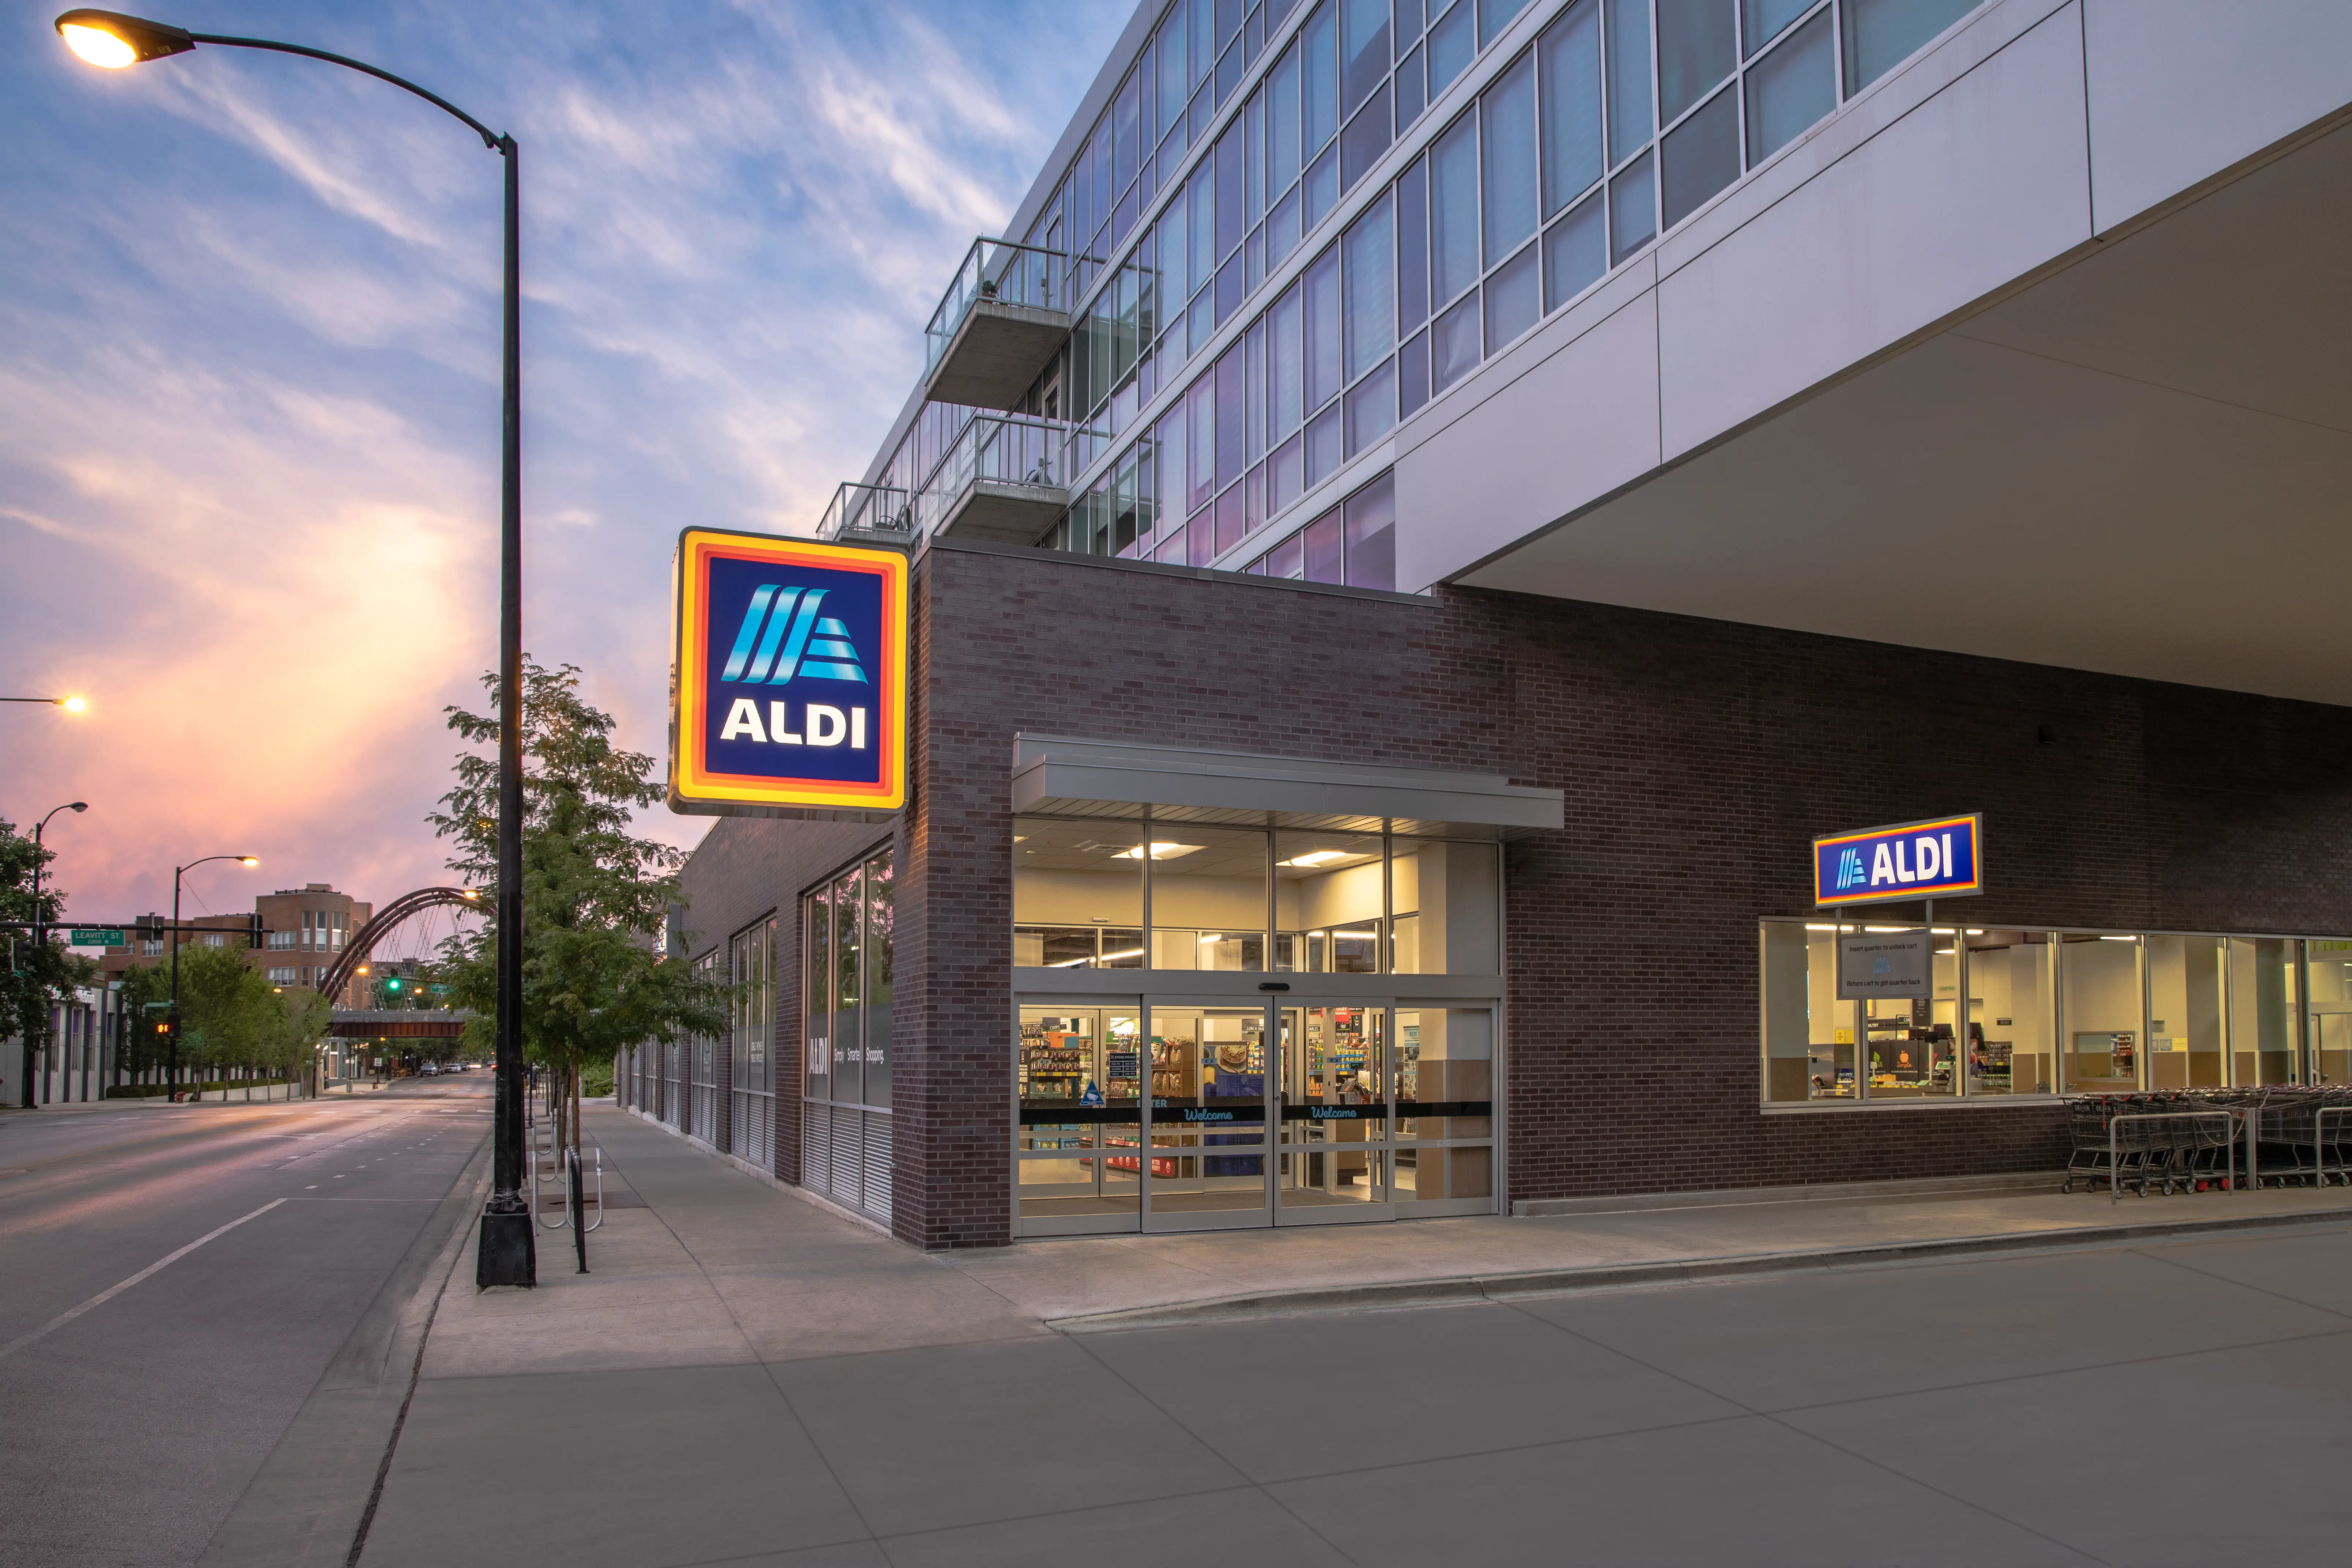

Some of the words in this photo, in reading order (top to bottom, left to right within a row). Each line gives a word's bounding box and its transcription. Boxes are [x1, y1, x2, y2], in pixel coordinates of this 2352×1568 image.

[720, 698, 866, 749] ALDI
[1870, 833, 1953, 886] ALDI
[809, 1037, 827, 1074] ALDI
[834, 1047, 844, 1064] Simply
[847, 1047, 860, 1061] Smarte
[1137, 1099, 1167, 1108] ETER
[1184, 1108, 1233, 1121] Welcome
[1311, 1106, 1357, 1118] Welcome
